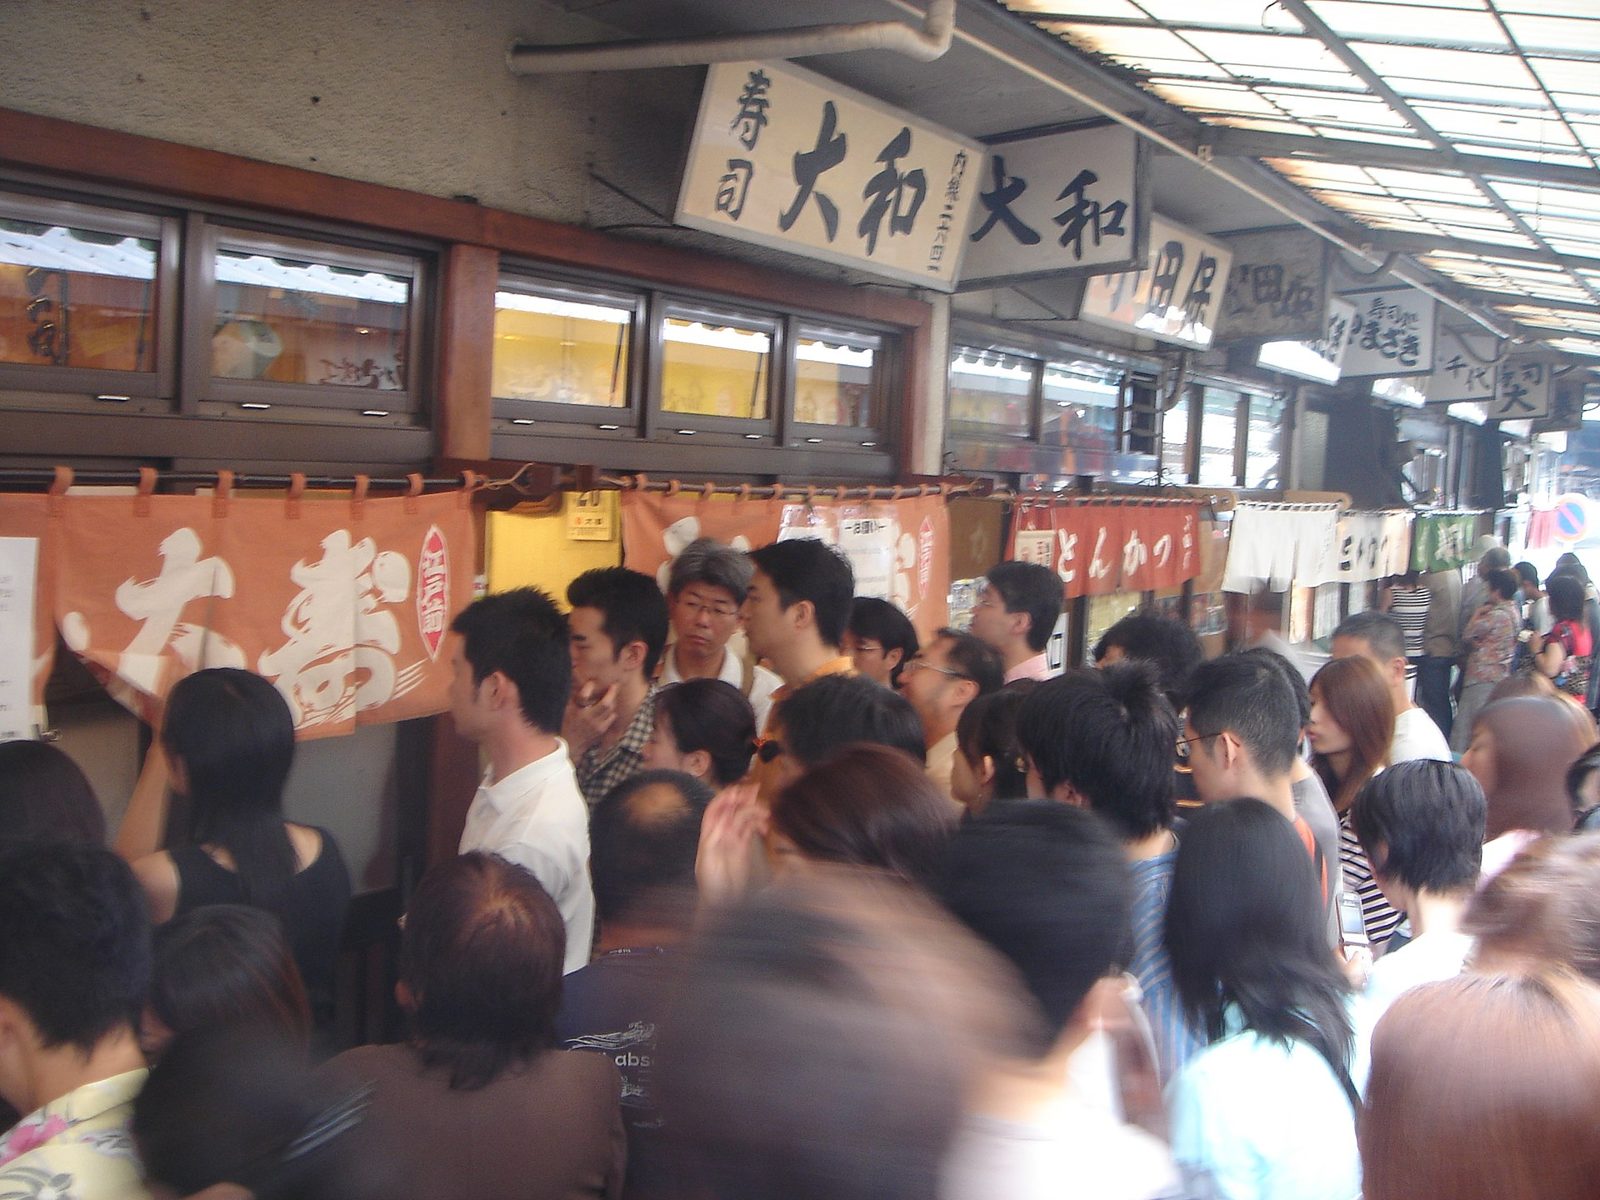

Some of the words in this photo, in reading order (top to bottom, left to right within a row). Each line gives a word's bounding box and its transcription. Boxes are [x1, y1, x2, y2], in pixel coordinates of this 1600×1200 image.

[715, 69, 772, 221] 寿司
[778, 100, 927, 256] 大和
[970, 156, 1128, 261] 大和
[1057, 526, 1172, 583] とんかつ
